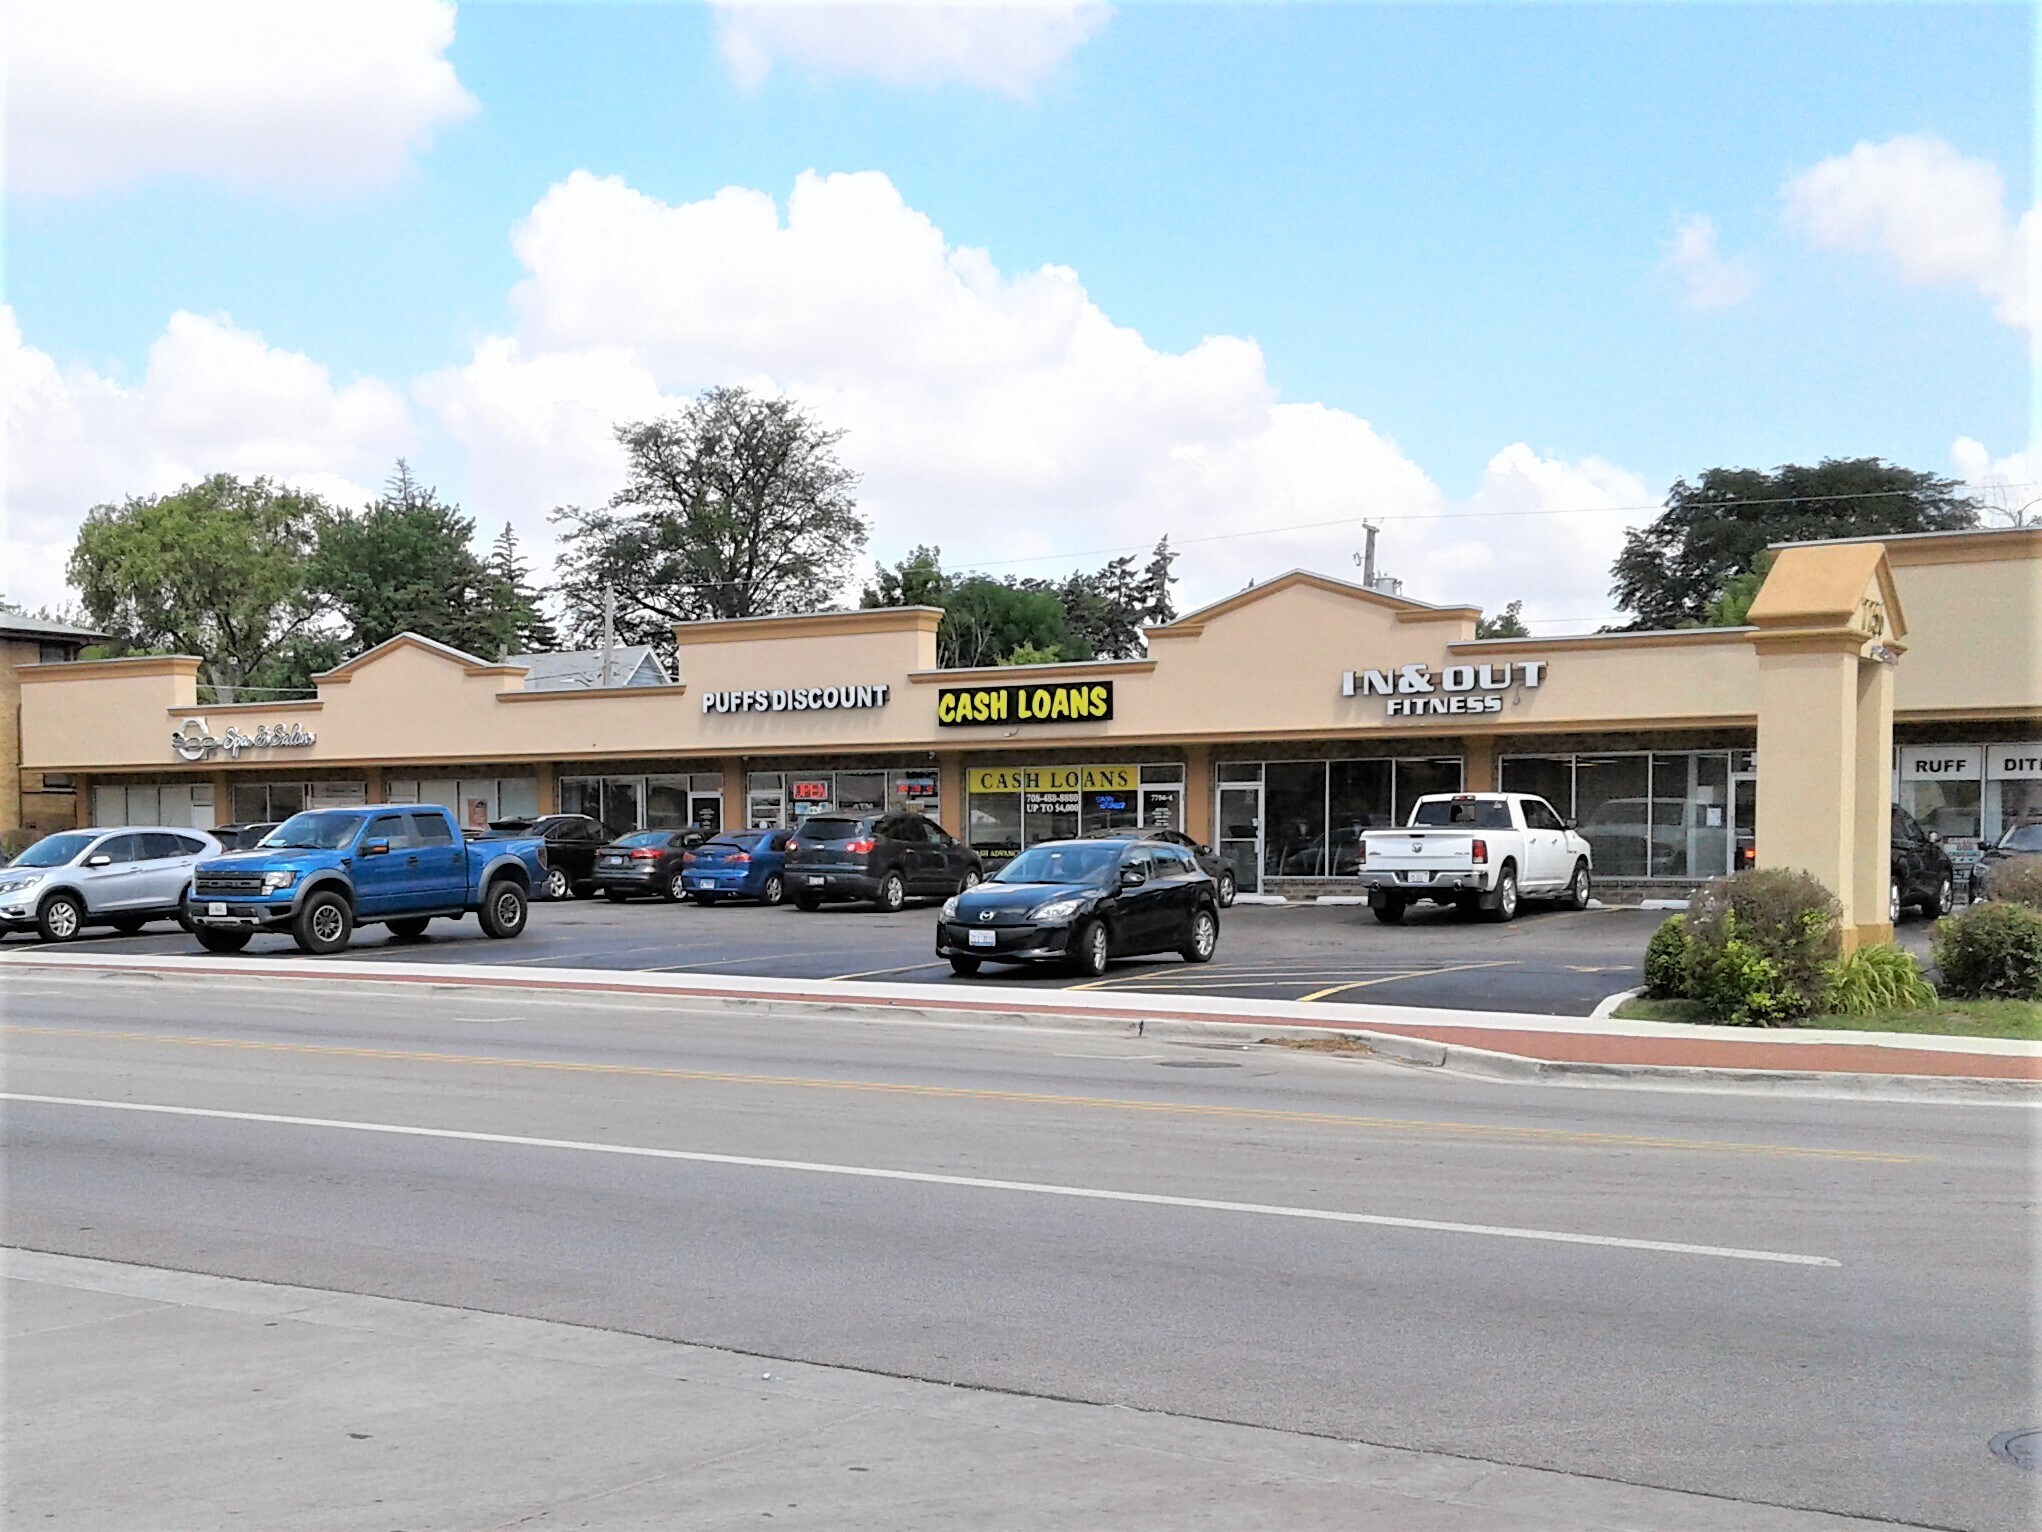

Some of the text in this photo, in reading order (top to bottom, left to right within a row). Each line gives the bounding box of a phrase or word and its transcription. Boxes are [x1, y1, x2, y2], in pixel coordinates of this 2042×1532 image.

[703, 684, 889, 713] PUFFS DISCOUNT
[938, 686, 1108, 723] CASH LOANS
[1386, 695, 1502, 715] FITNESS
[223, 727, 251, 758] Spa
[270, 723, 315, 747] Salon
[1915, 758, 2042, 772] RUFF DIT
[980, 770, 1128, 789] CASH LOANS
[796, 783, 826, 798] OPEN
[1026, 803, 1039, 812] UP
[1040, 803, 1054, 812] TO
